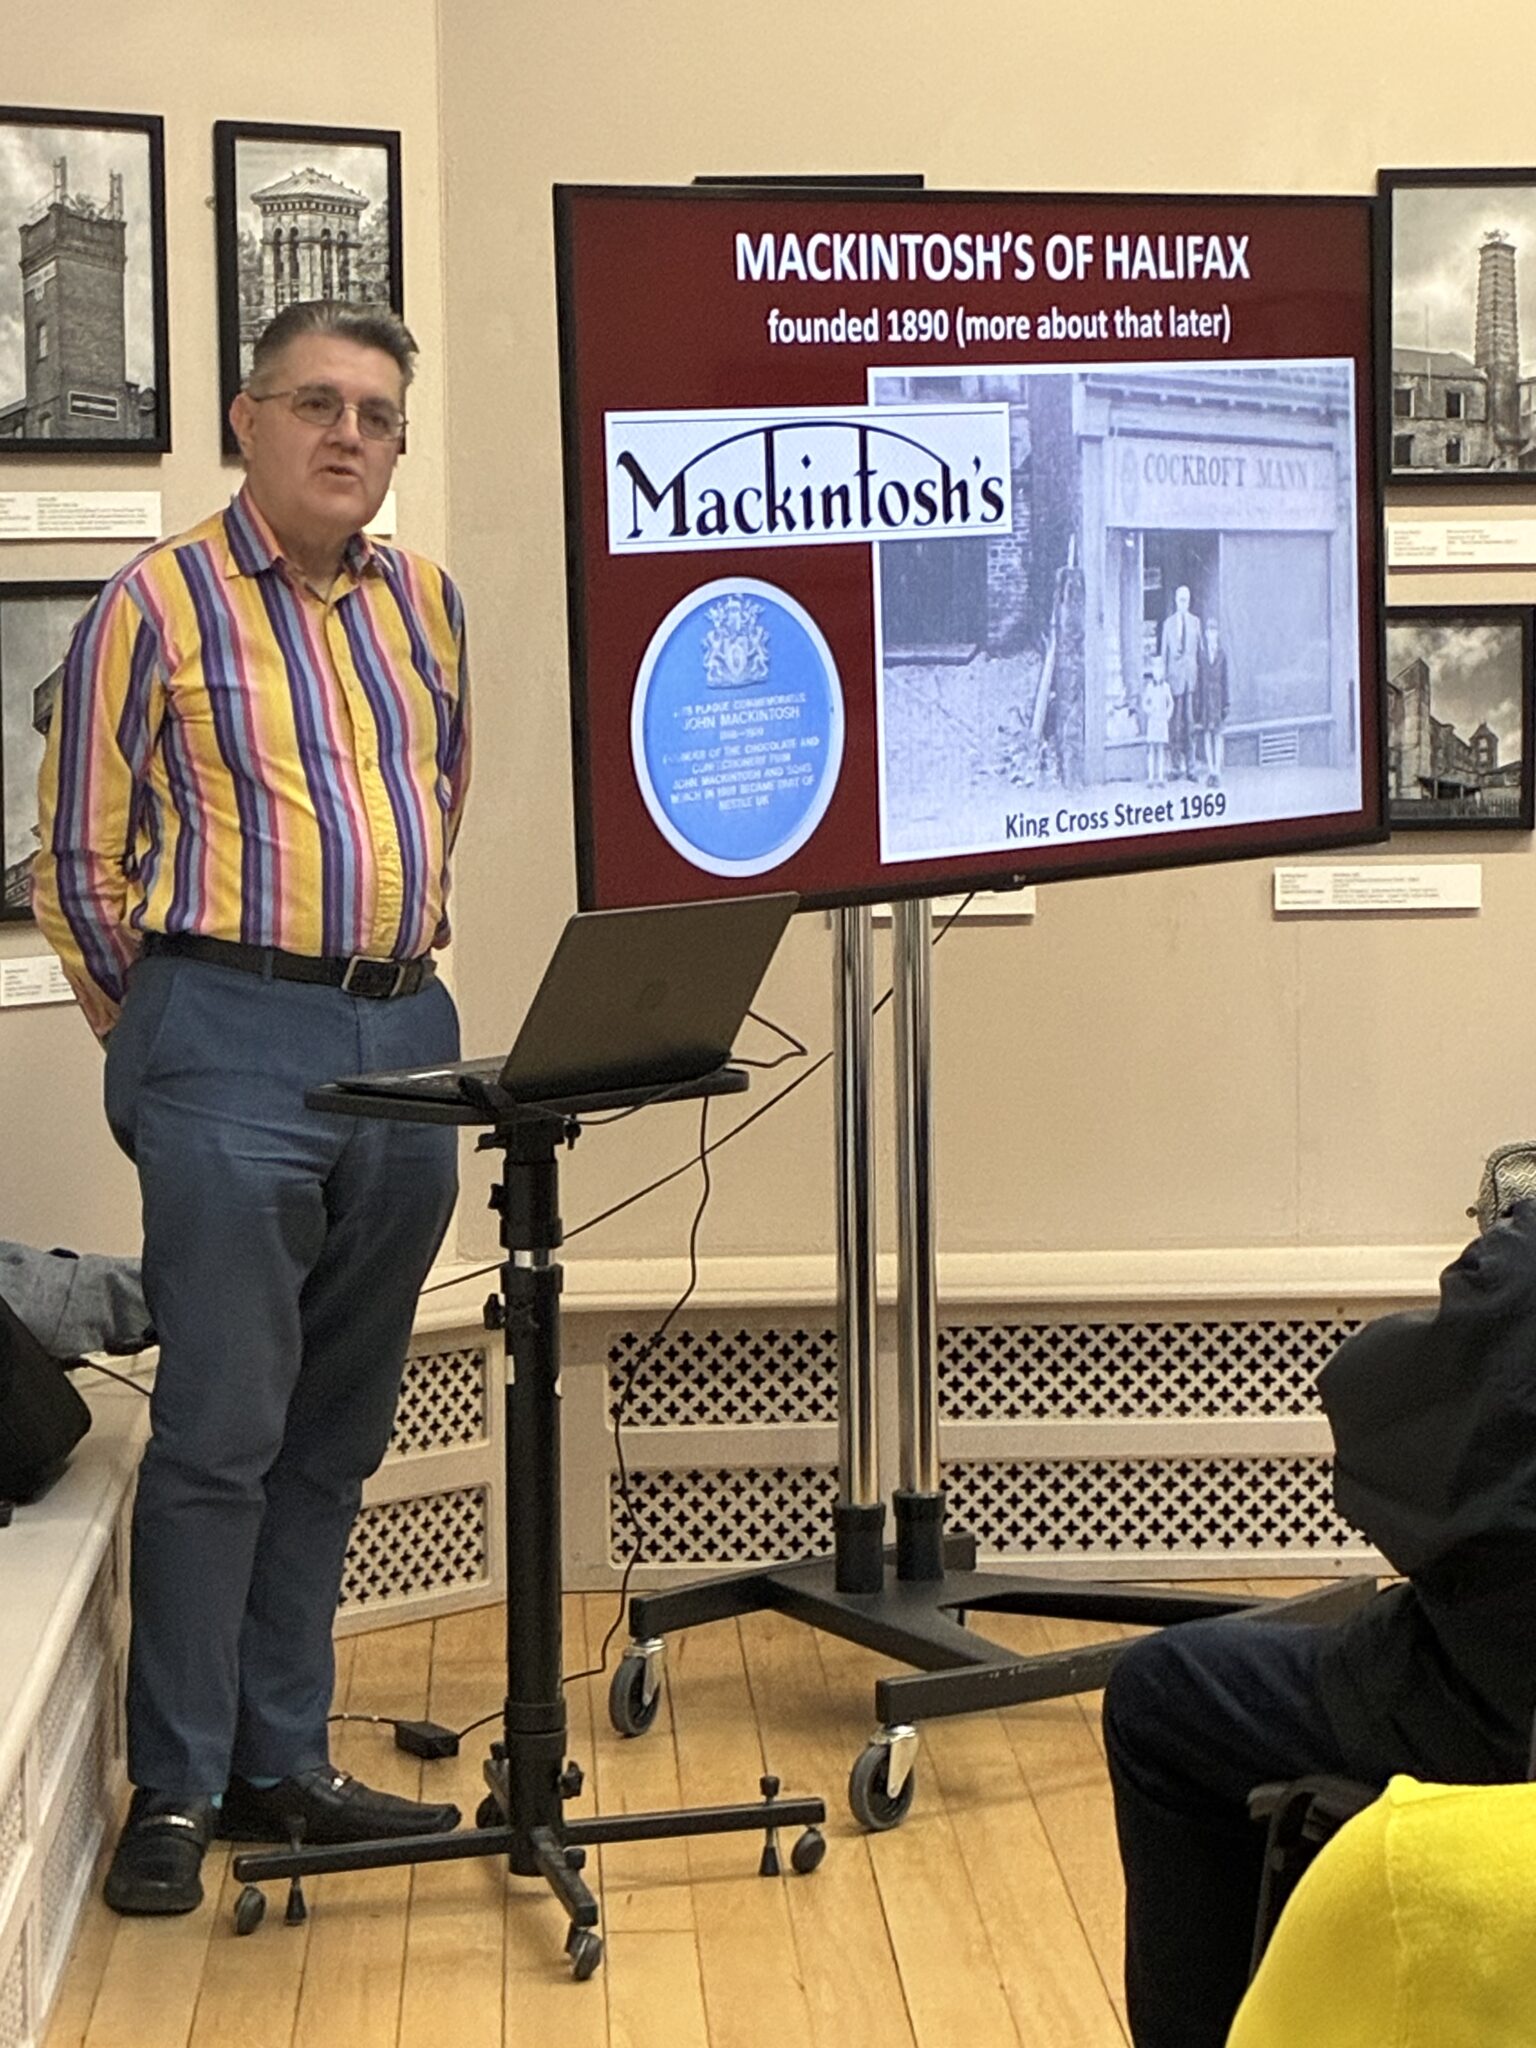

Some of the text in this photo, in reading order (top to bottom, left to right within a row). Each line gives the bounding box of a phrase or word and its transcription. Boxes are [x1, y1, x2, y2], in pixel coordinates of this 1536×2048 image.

[733, 231, 1251, 282] MACKINTOSH'S OF HALIFAX
[767, 304, 1232, 348] founded 1890 (more about that later)
[616, 421, 1003, 540] Mackintosh's
[1142, 453, 1247, 488] COCKROFT
[683, 705, 801, 731] JOHN MACKINTOSH
[1005, 792, 1227, 839] King Cross Street 1969
